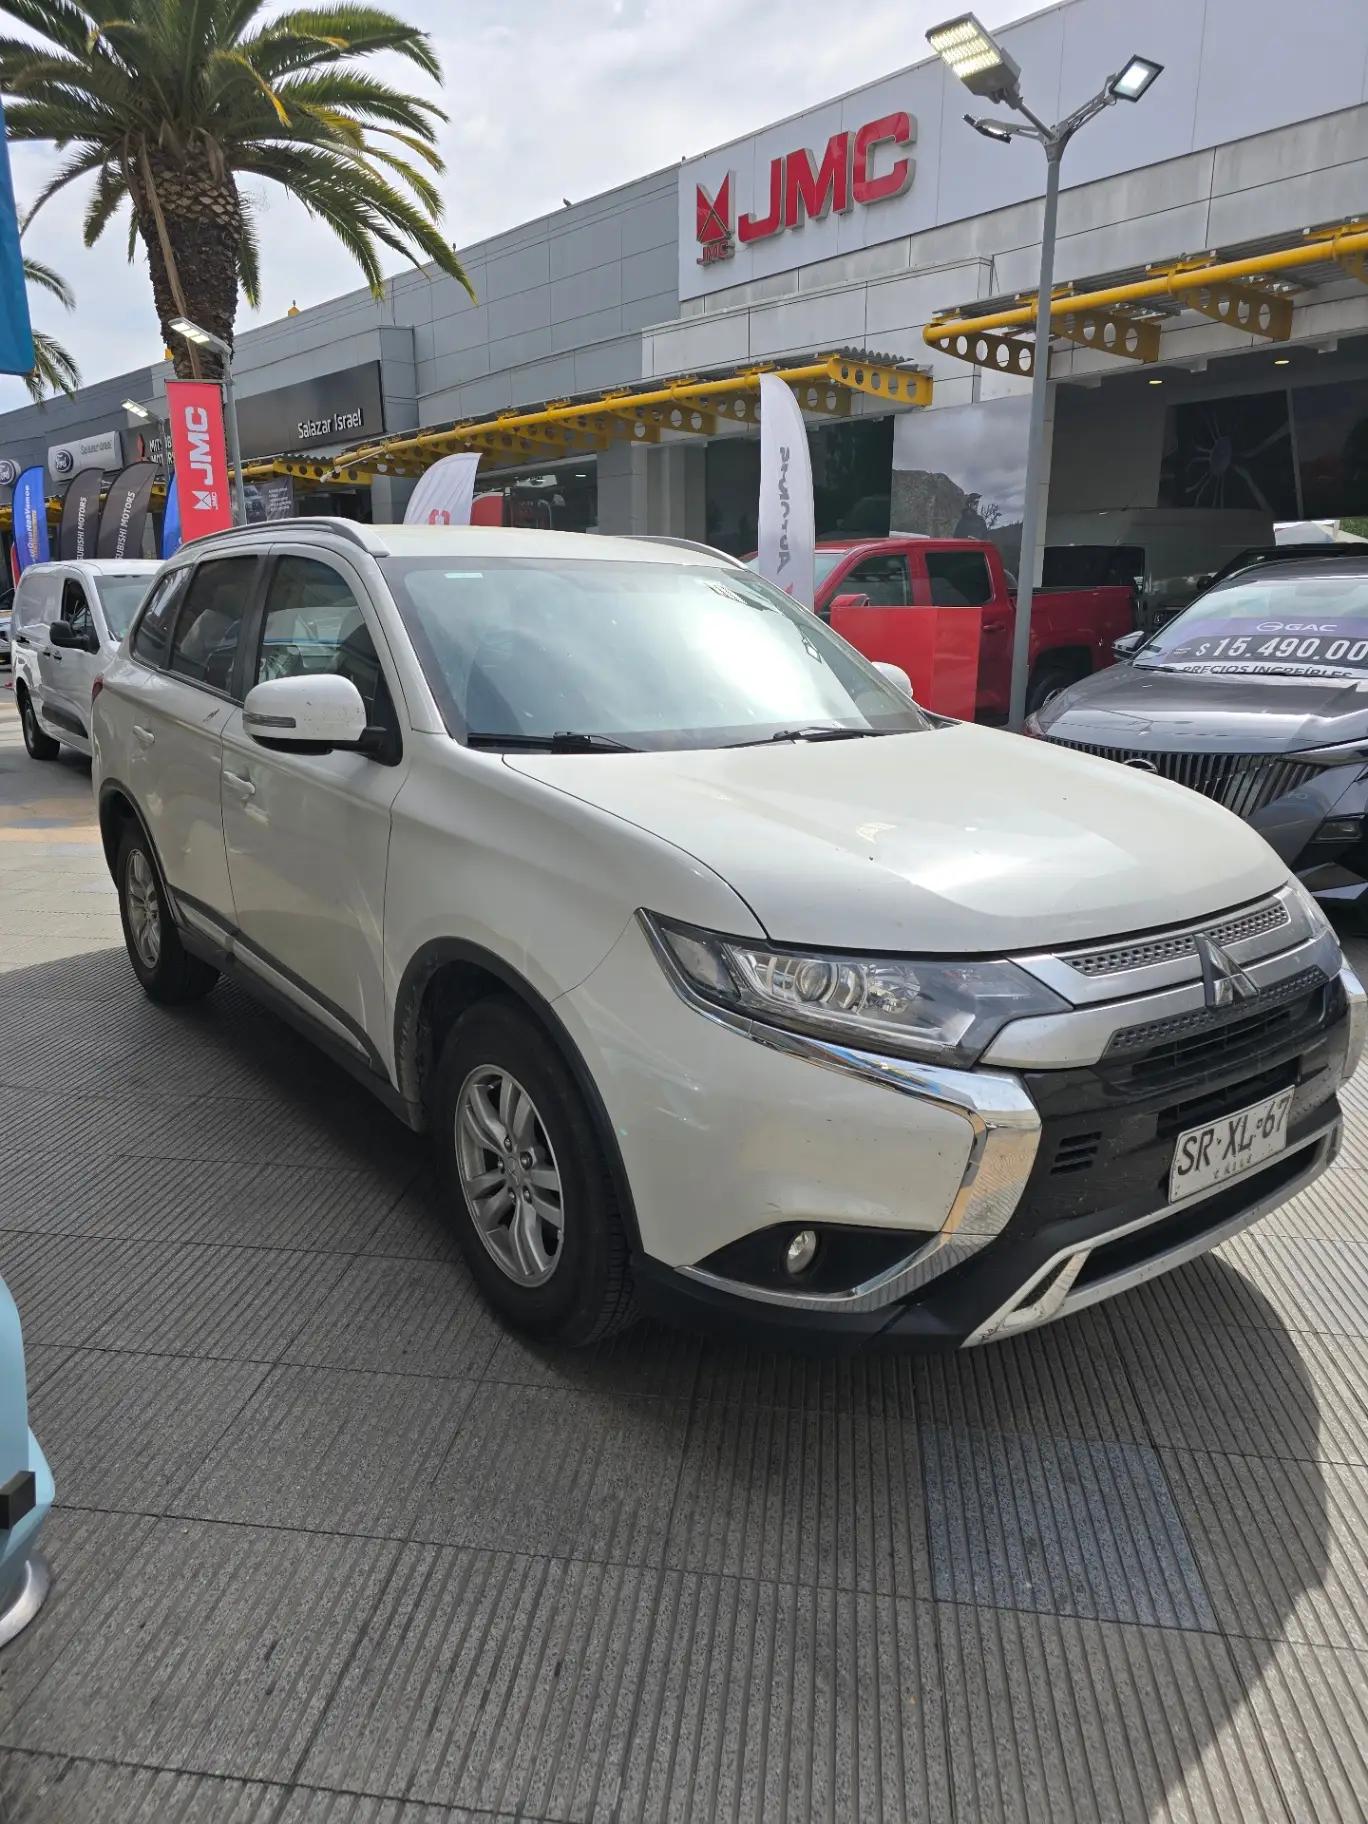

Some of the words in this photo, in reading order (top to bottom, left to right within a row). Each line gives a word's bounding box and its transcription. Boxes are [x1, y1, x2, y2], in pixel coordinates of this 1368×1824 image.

[738, 111, 911, 243] JMC
[697, 240, 730, 266] JMC
[297, 421, 331, 438] Salazar
[334, 408, 361, 431] Israel
[185, 406, 214, 485] JMC
[78, 497, 87, 530] MOTORS
[120, 491, 136, 528] MOTORS
[1284, 623, 1338, 632] GAC
